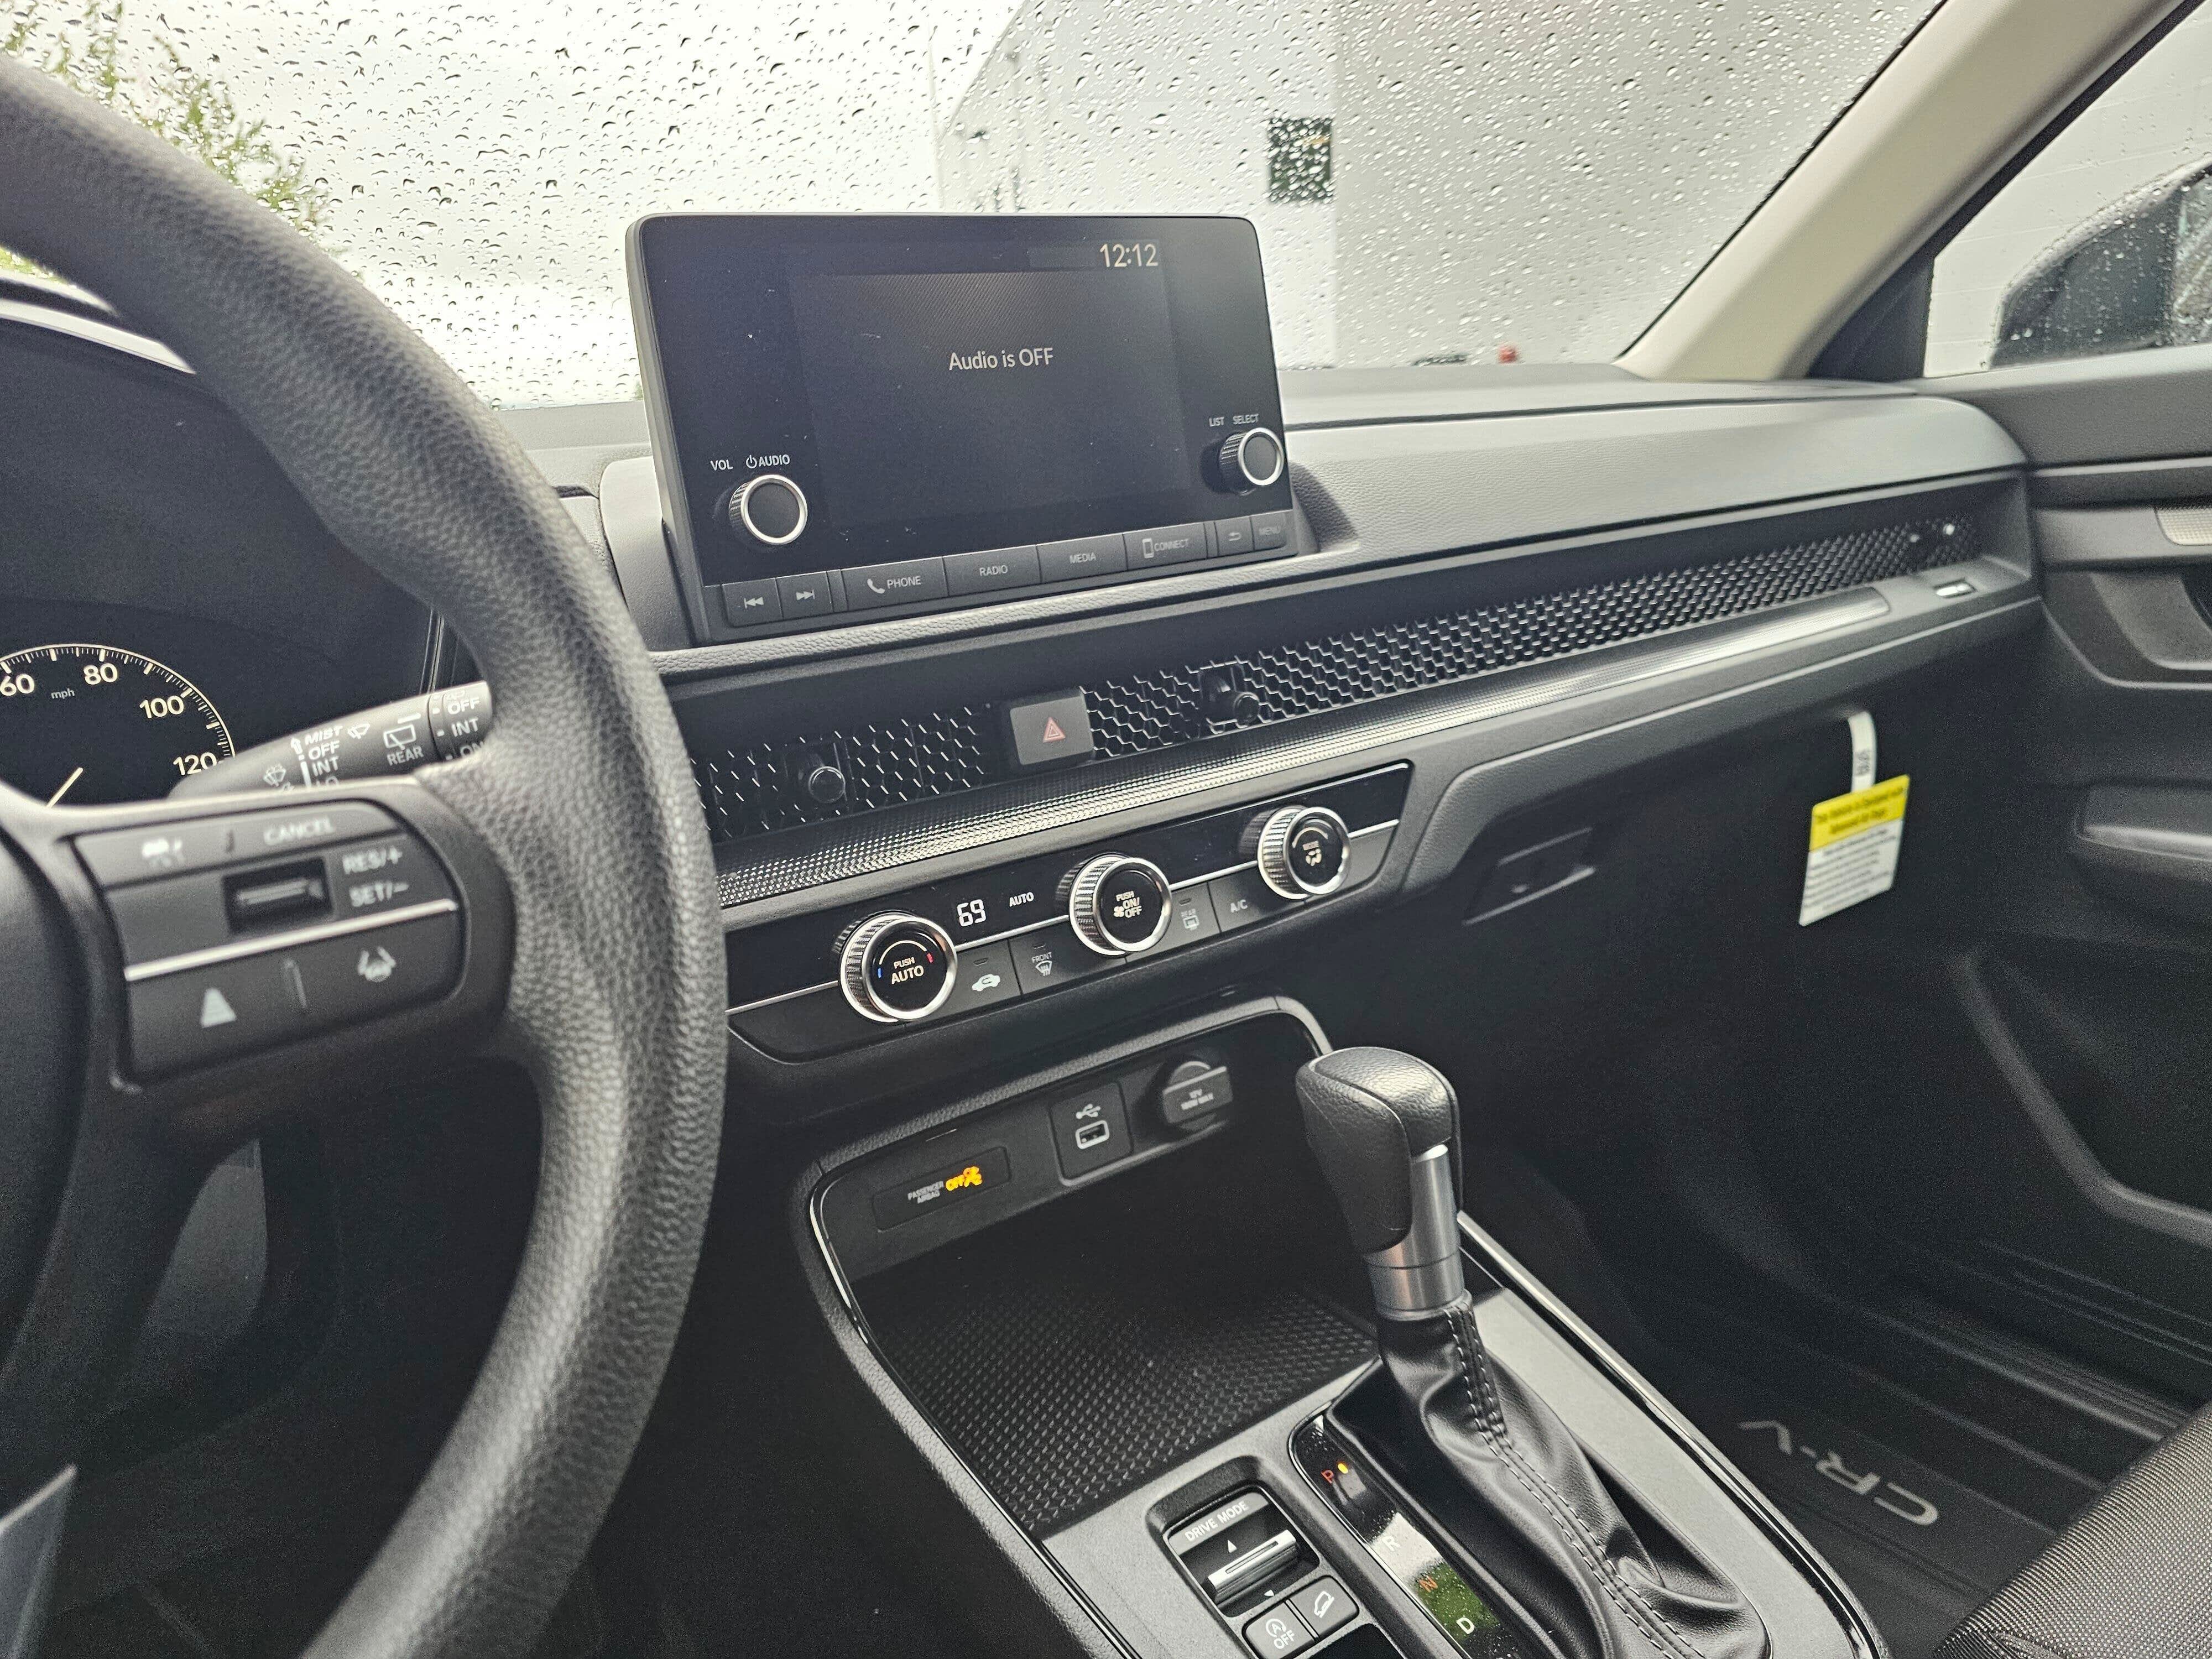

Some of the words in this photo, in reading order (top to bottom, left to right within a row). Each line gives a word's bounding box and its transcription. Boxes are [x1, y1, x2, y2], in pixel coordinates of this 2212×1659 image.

[1099, 243, 1158, 268] 12:12
[949, 351, 998, 371] Audio
[1001, 350, 1016, 368] is
[1019, 347, 1053, 368] OFF
[1209, 416, 1225, 427] LIST
[1233, 413, 1259, 425] SELECT
[710, 459, 733, 471] VOL
[759, 454, 790, 467] AUDIO
[1154, 538, 1188, 552] CONNECT
[1070, 552, 1097, 564] MEDIA
[979, 565, 1008, 577] RADIO
[886, 576, 922, 589] PHONE
[83, 662, 118, 686] 80
[0, 673, 35, 697] 60
[50, 688, 75, 700] mph
[139, 695, 184, 719] 100
[447, 697, 481, 714] OFF
[305, 726, 343, 745] MIST
[451, 718, 479, 737] INT
[308, 740, 340, 760] OFF
[387, 745, 424, 766] REAR
[173, 752, 217, 776] 120
[312, 755, 339, 776] INT
[263, 815, 334, 846] CANCEL
[342, 846, 403, 874] RES/+
[1115, 891, 1135, 902] PUSH
[1122, 897, 1140, 910] ON/
[1230, 899, 1248, 913] A/C
[957, 899, 987, 927] 69
[1009, 891, 1035, 907] AUTO
[1124, 905, 1142, 919] OFF
[1181, 908, 1197, 917] REAR
[894, 957, 916, 969] PUSH
[1031, 952, 1052, 964] FRONT
[891, 965, 924, 985] AUTO
[1321, 1469, 1335, 1484] P
[1736, 1420, 1939, 1526] CR-V
[1184, 1518, 1218, 1542] DRIVE
[1217, 1501, 1250, 1524] MODE
[1382, 1535, 1401, 1552] R
[1417, 1575, 1438, 1593] N
[1455, 1616, 1475, 1635] D
[1273, 1630, 1296, 1650] OFF
